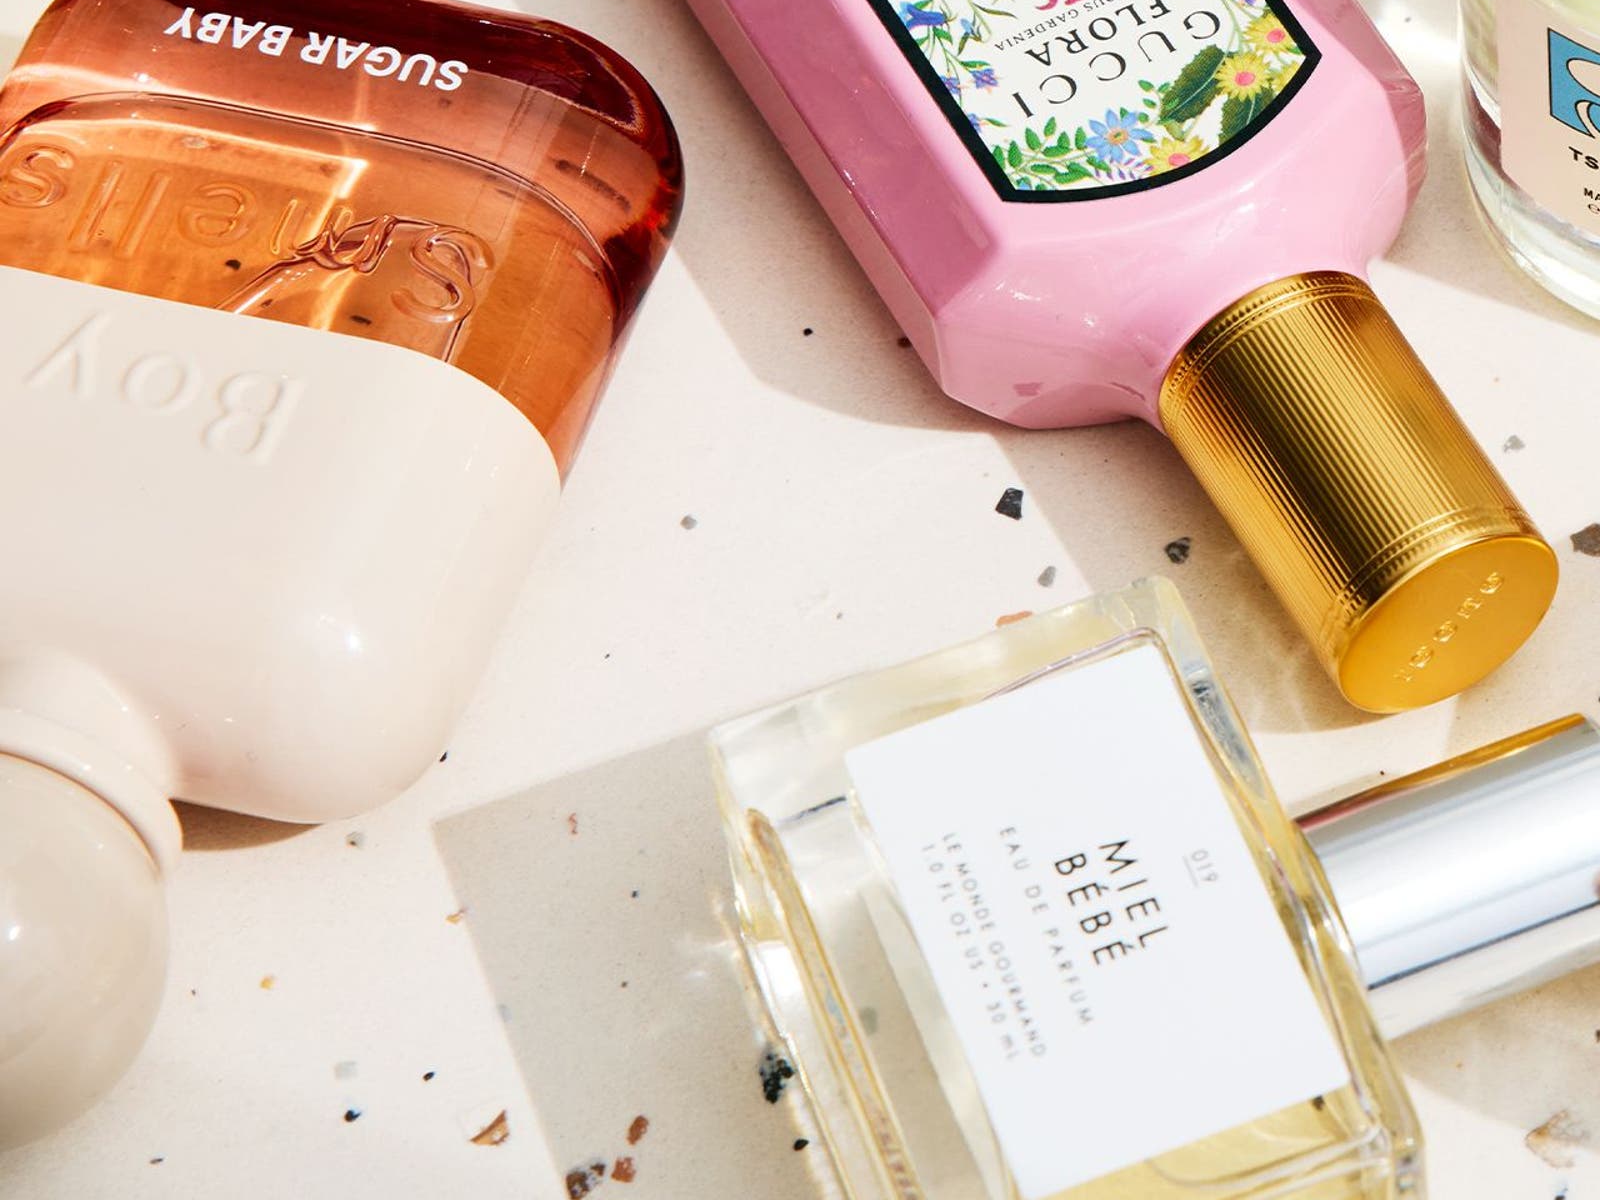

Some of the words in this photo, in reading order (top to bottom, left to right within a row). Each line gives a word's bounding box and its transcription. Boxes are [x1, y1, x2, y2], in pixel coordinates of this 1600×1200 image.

[165, 6, 291, 57] BABY
[299, 30, 469, 92] SUGAR
[994, 7, 1080, 52] GARDENIA
[1012, 10, 1221, 119] GUCCI
[1054, 852, 1135, 966] BÉBÉ
[1098, 839, 1169, 950] MIEL
[1189, 848, 1220, 885] 019
[942, 832, 963, 853] LE
[956, 862, 996, 932] MONDE
[988, 940, 1047, 1057] GOURMAND
[963, 946, 985, 971] US
[999, 826, 1031, 871] EAU
[1024, 884, 1049, 915] DE
[1043, 927, 1093, 1025] PARFUM
